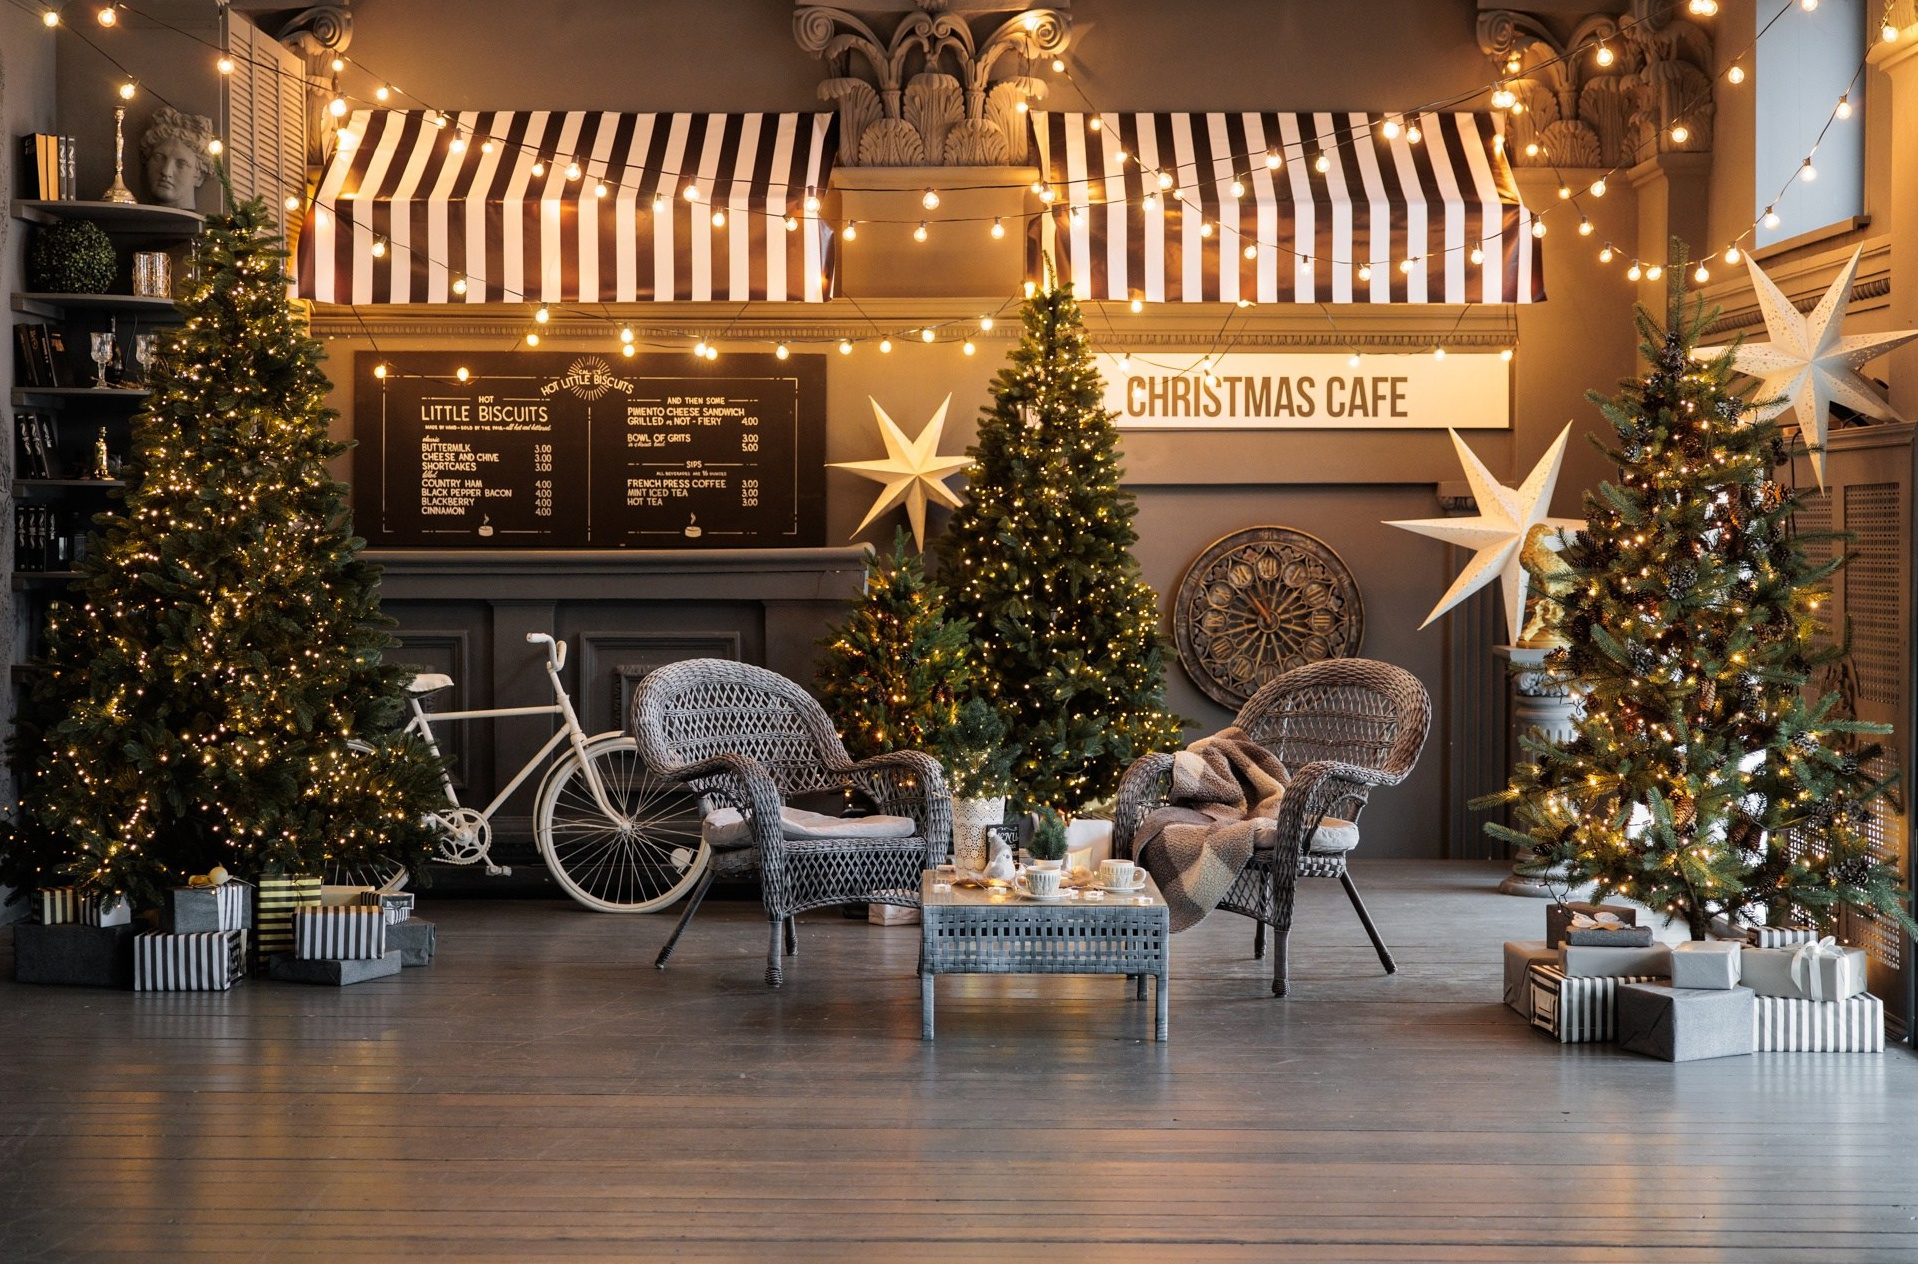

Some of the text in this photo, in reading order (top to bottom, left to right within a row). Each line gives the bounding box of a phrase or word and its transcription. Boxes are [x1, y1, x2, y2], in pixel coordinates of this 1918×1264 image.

[540, 375, 635, 396] HOT LITTLE BISCUITS
[685, 397, 704, 405] THEN
[706, 397, 726, 405] SOME
[1127, 376, 1408, 418] CHRISTMAS CAFE
[421, 405, 548, 422] LITTLE BISCUITS
[627, 407, 745, 417] PIMENTO CHEESE SANDWICH
[627, 417, 664, 426] GRILLED
[673, 417, 691, 426] NOT
[698, 417, 722, 426] FIERY
[741, 417, 758, 426] 4.00
[627, 433, 758, 443] BOWL OF GRITS 3.00
[421, 443, 552, 453] BUTTERMILK 3.00
[741, 443, 758, 452] 5.00
[421, 453, 552, 462] CHEESE AND CHIVE 3.00
[421, 462, 552, 472] SHORTCAKES 3.00
[421, 479, 552, 489] COUNTRY HAM 4.00
[627, 479, 759, 489] FRENCH PRESS COFFEE 3.00
[421, 488, 552, 498] BLACK PEPPER BACON 4.00
[627, 488, 759, 498] MINT ICED TEA 3.00
[421, 498, 552, 507] BLACKBERRY 4.00
[627, 498, 759, 507] HOT TEA 3.00
[421, 506, 552, 516] CINNAMON 4.00
[1261, 558, 1276, 575] XII
[1233, 565, 1249, 584] XI
[1214, 588, 1230, 601] X
[1313, 615, 1330, 627] III
